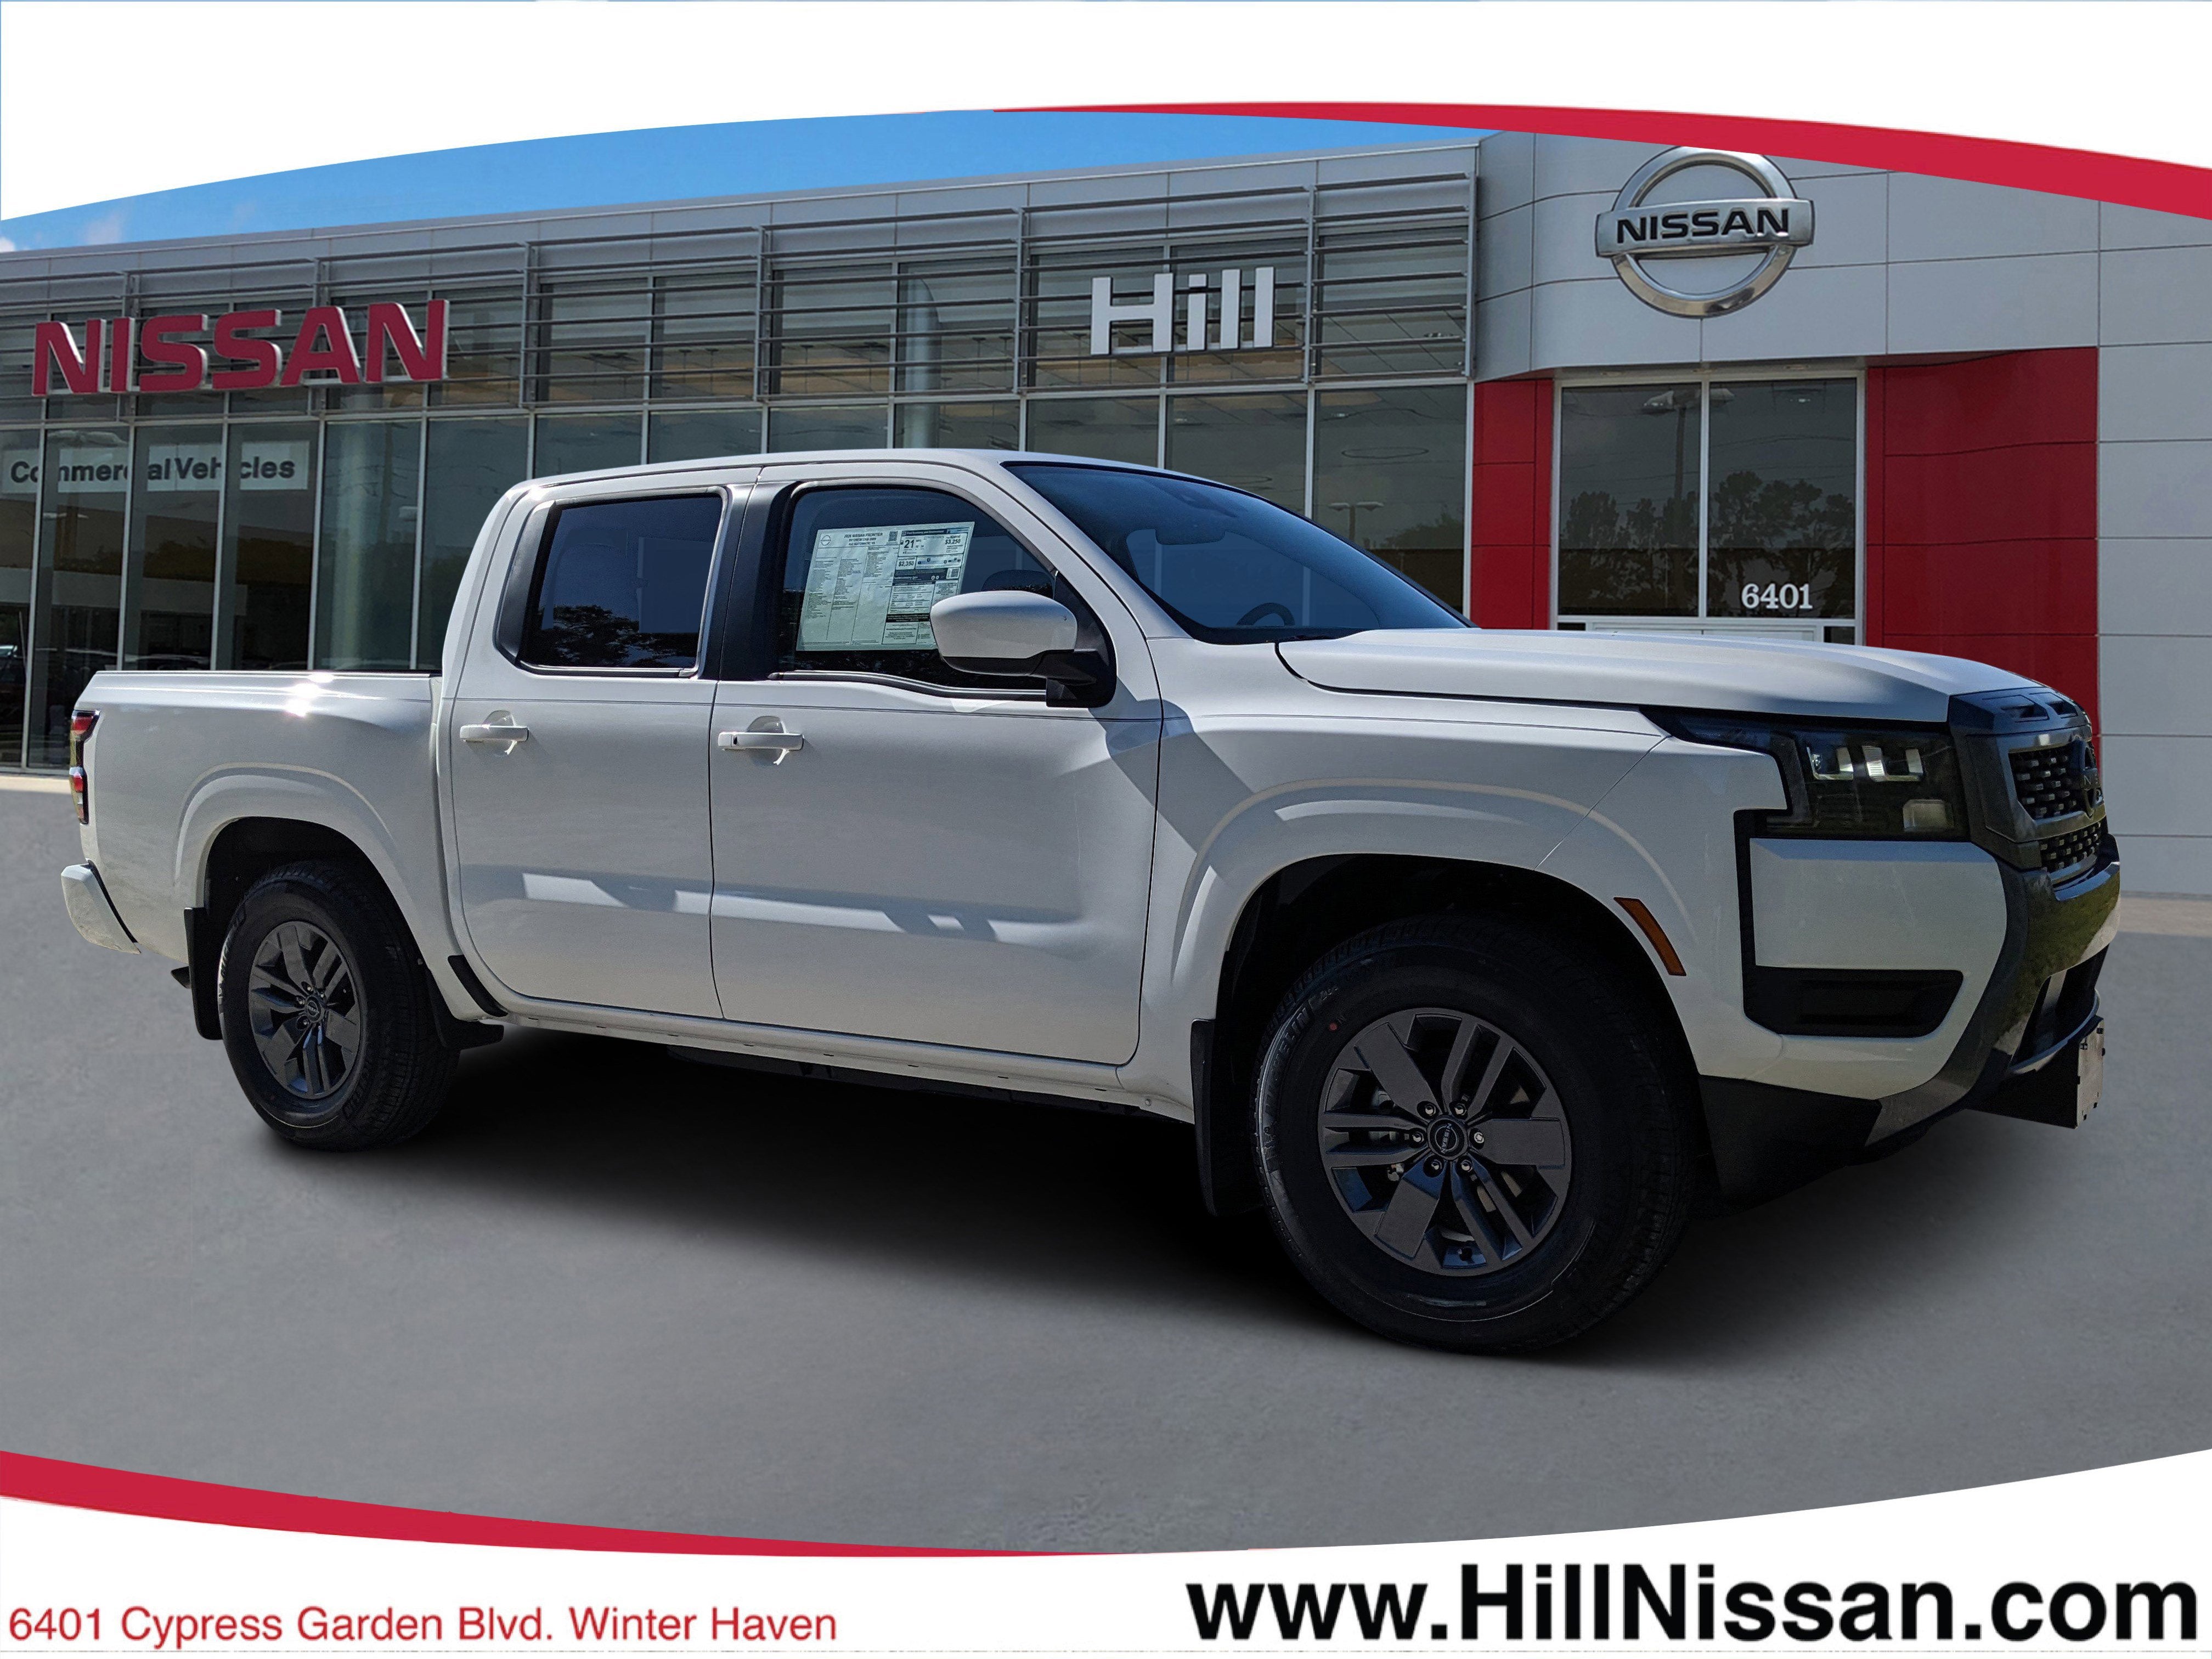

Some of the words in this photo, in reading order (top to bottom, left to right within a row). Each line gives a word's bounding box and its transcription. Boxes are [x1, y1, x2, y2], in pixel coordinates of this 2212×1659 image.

[1617, 207, 1789, 244] NISSAN
[1090, 266, 1275, 356] Hill
[31, 300, 449, 397] NISSAN
[174, 456, 295, 479] Vehcles
[904, 539, 915, 549] 21
[1741, 583, 1813, 610] 6401
